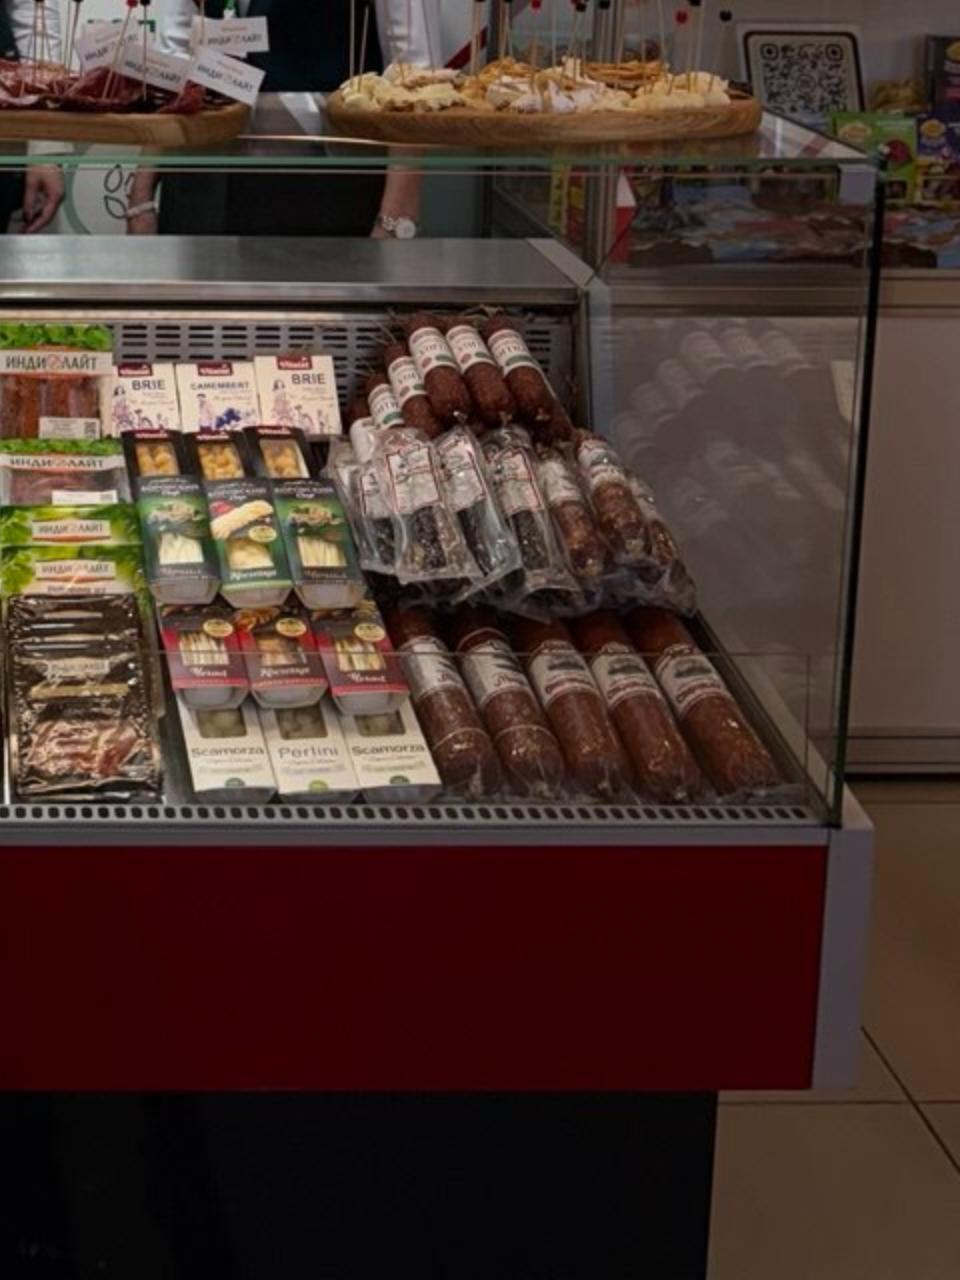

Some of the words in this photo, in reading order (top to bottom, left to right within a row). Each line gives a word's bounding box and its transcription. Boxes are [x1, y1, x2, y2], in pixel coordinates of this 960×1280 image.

[131, 378, 167, 391] BRIE
[291, 372, 327, 385] BRIE
[189, 380, 251, 391] CAMEMBERT
[191, 744, 265, 759] Scamorza
[351, 742, 426, 757] Scamorza
